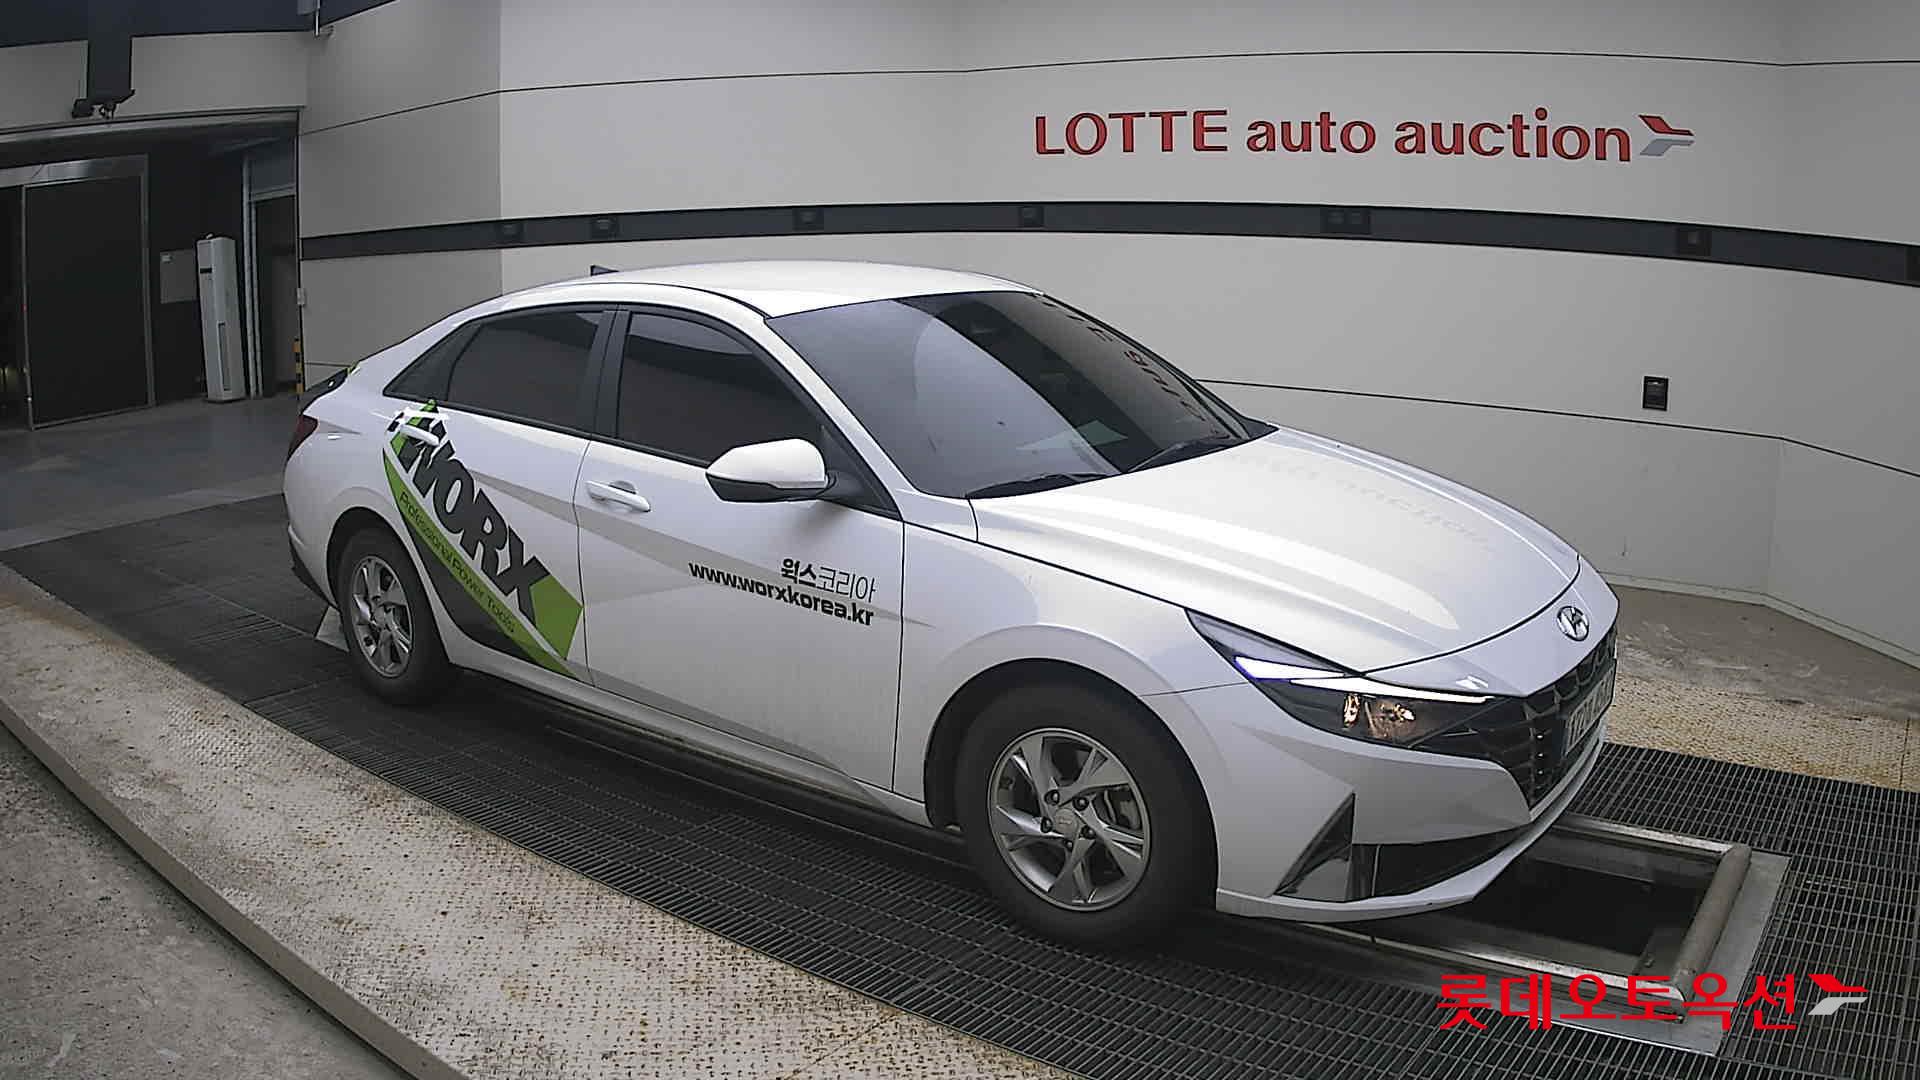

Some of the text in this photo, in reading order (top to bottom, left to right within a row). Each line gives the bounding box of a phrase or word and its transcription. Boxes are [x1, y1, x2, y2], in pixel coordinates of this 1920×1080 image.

[1035, 107, 1632, 163] LOTTE auto auction
[397, 417, 551, 627] WORX
[688, 562, 875, 626] www.worxkorea.kr
[780, 558, 876, 603] 웍스코리아
